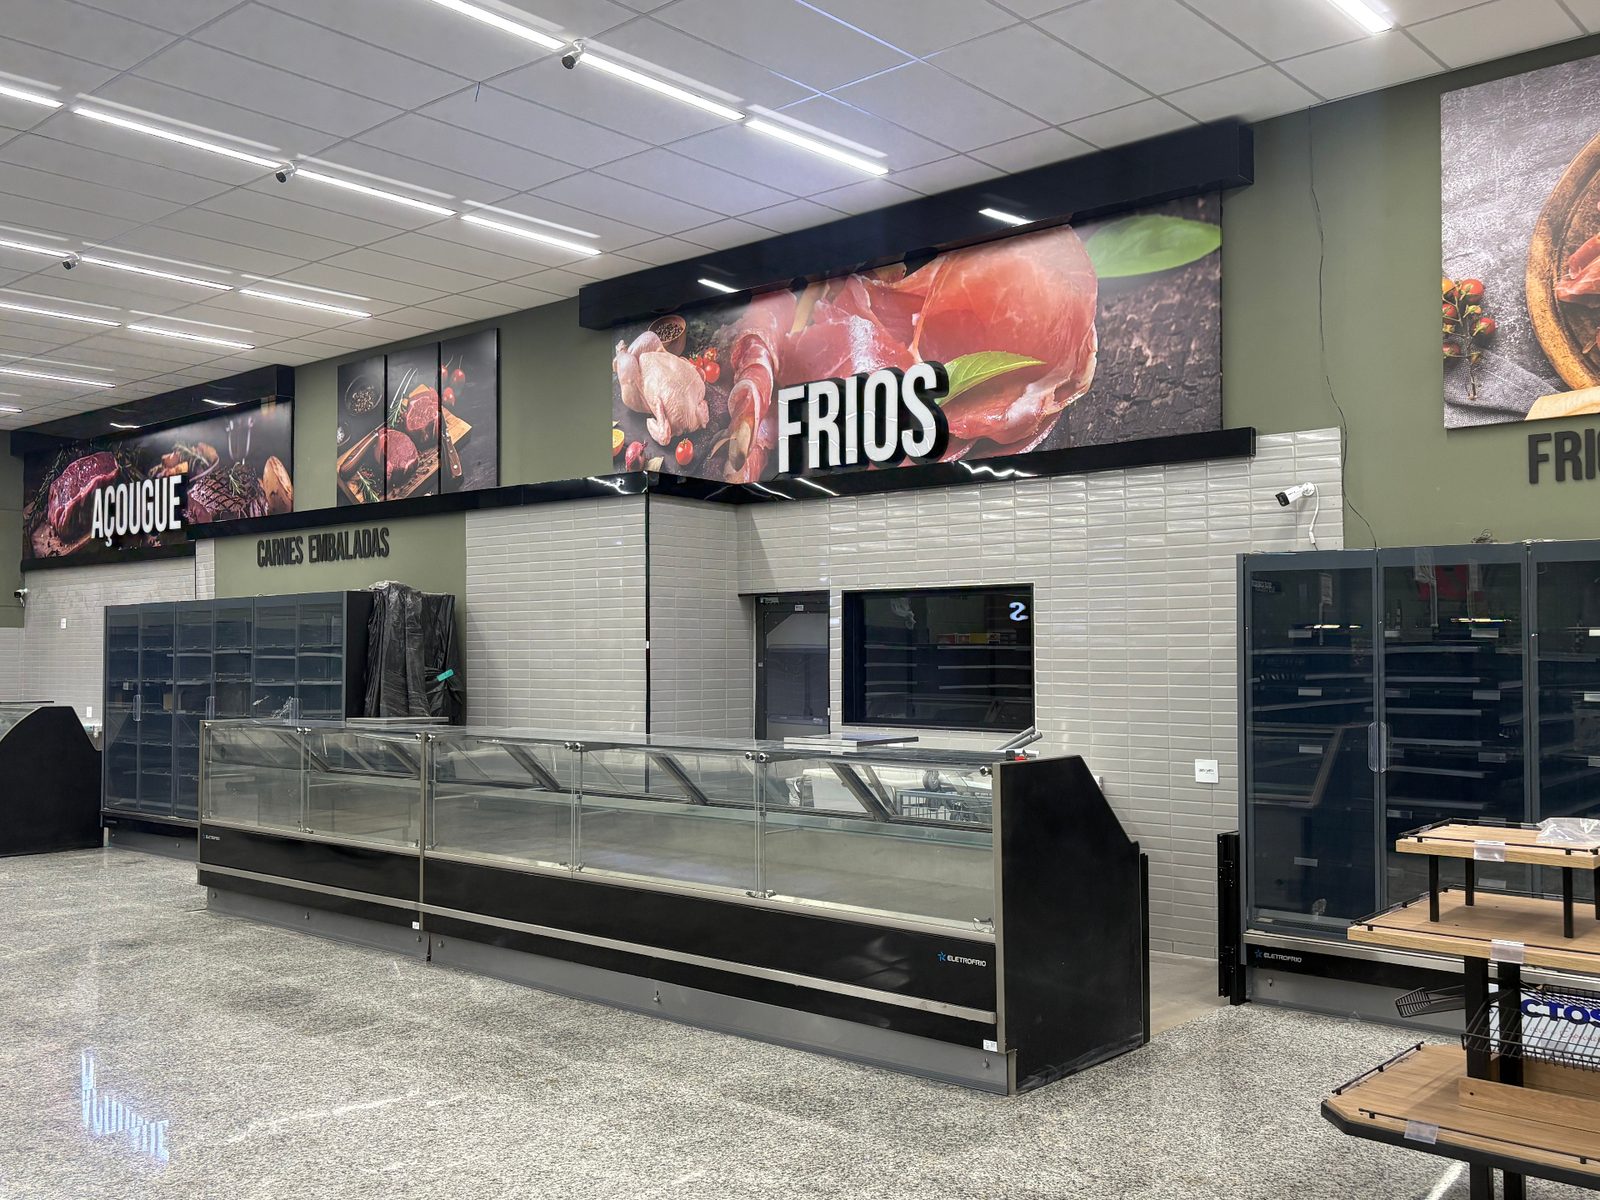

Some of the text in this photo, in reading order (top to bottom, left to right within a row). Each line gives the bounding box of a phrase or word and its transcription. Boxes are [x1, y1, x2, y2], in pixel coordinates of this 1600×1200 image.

[778, 362, 939, 474] FRIOS
[1528, 428, 1600, 485] FRI
[91, 475, 182, 547] AÇOUGUE
[256, 527, 390, 568] CARNES EMBALADAS
[946, 954, 987, 967] ELETROFRIO
